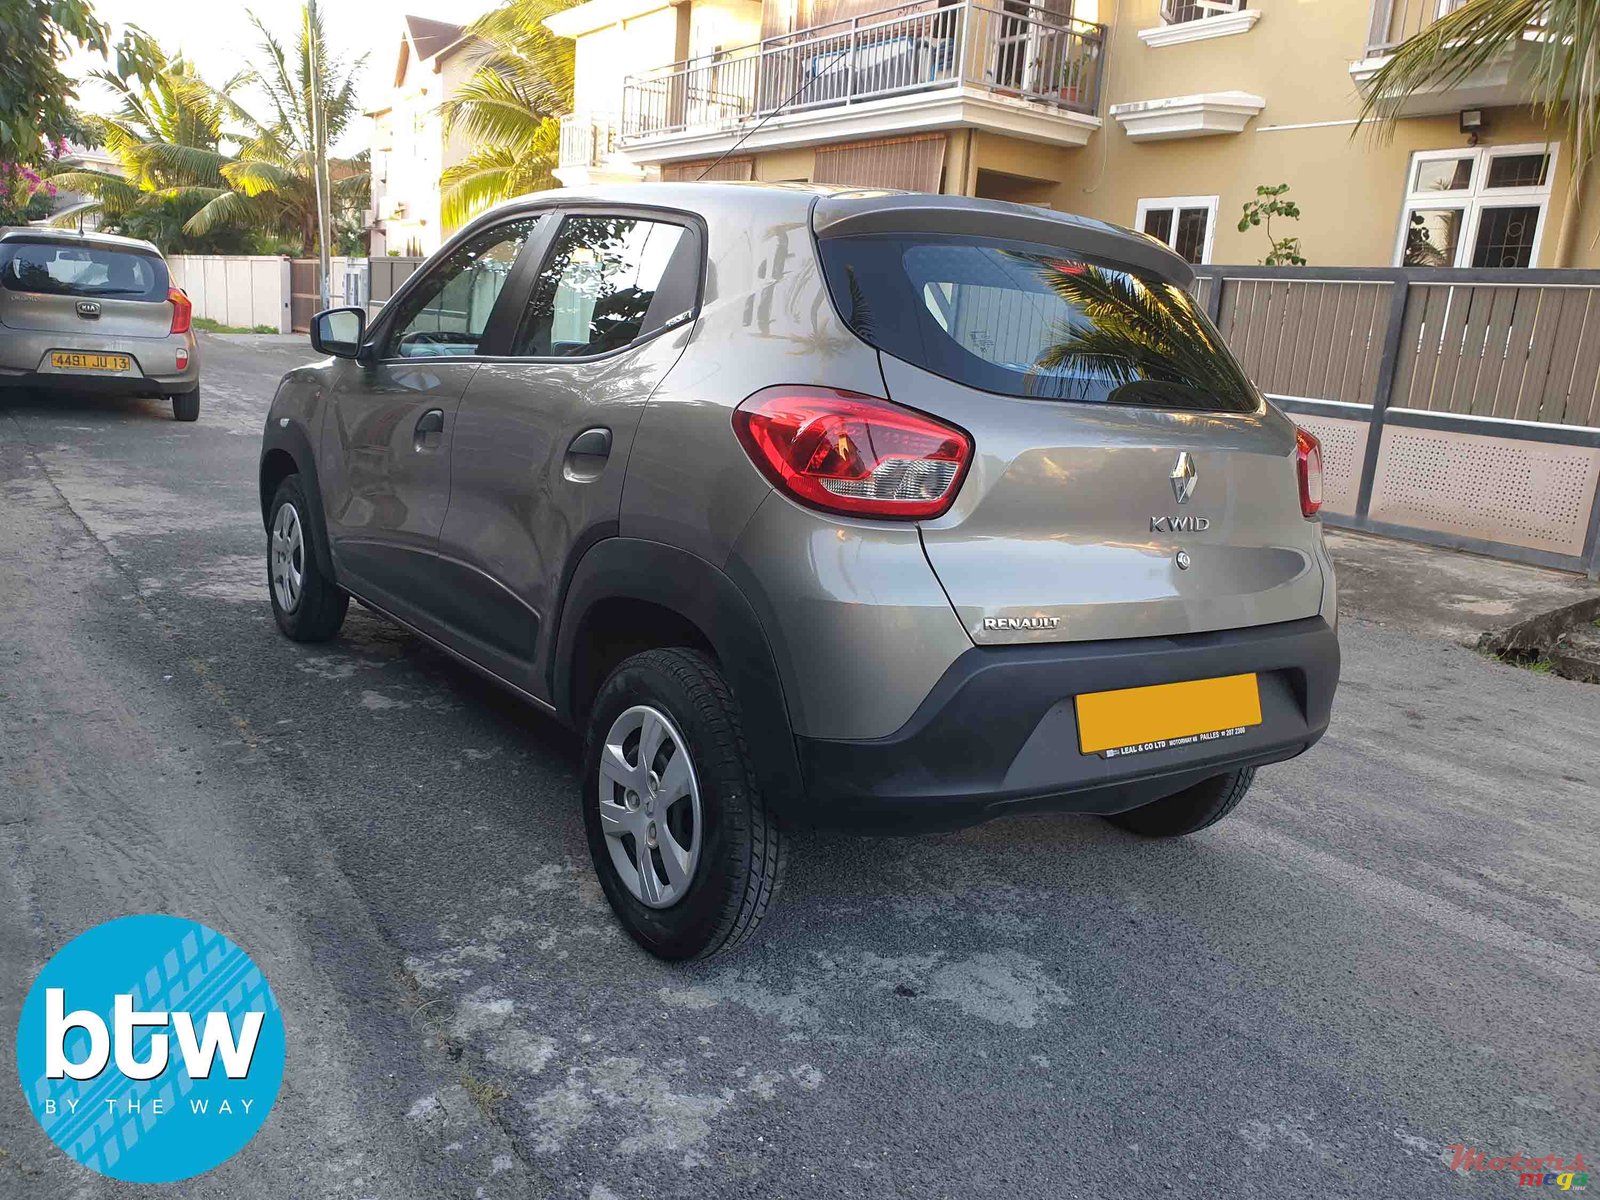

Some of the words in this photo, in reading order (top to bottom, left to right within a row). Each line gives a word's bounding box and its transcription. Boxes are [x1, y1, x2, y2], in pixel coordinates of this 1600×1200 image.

[56, 354, 86, 366] 4491
[92, 356, 108, 368] JU
[113, 358, 127, 369] 13
[1150, 516, 1209, 532] KWID
[984, 617, 1060, 630] RENAULT
[1121, 745, 1137, 755] LEAL
[1138, 744, 1144, 752] &
[1144, 743, 1154, 751] CO
[1154, 740, 1166, 749] LTD
[1200, 731, 1220, 741] PAILLES
